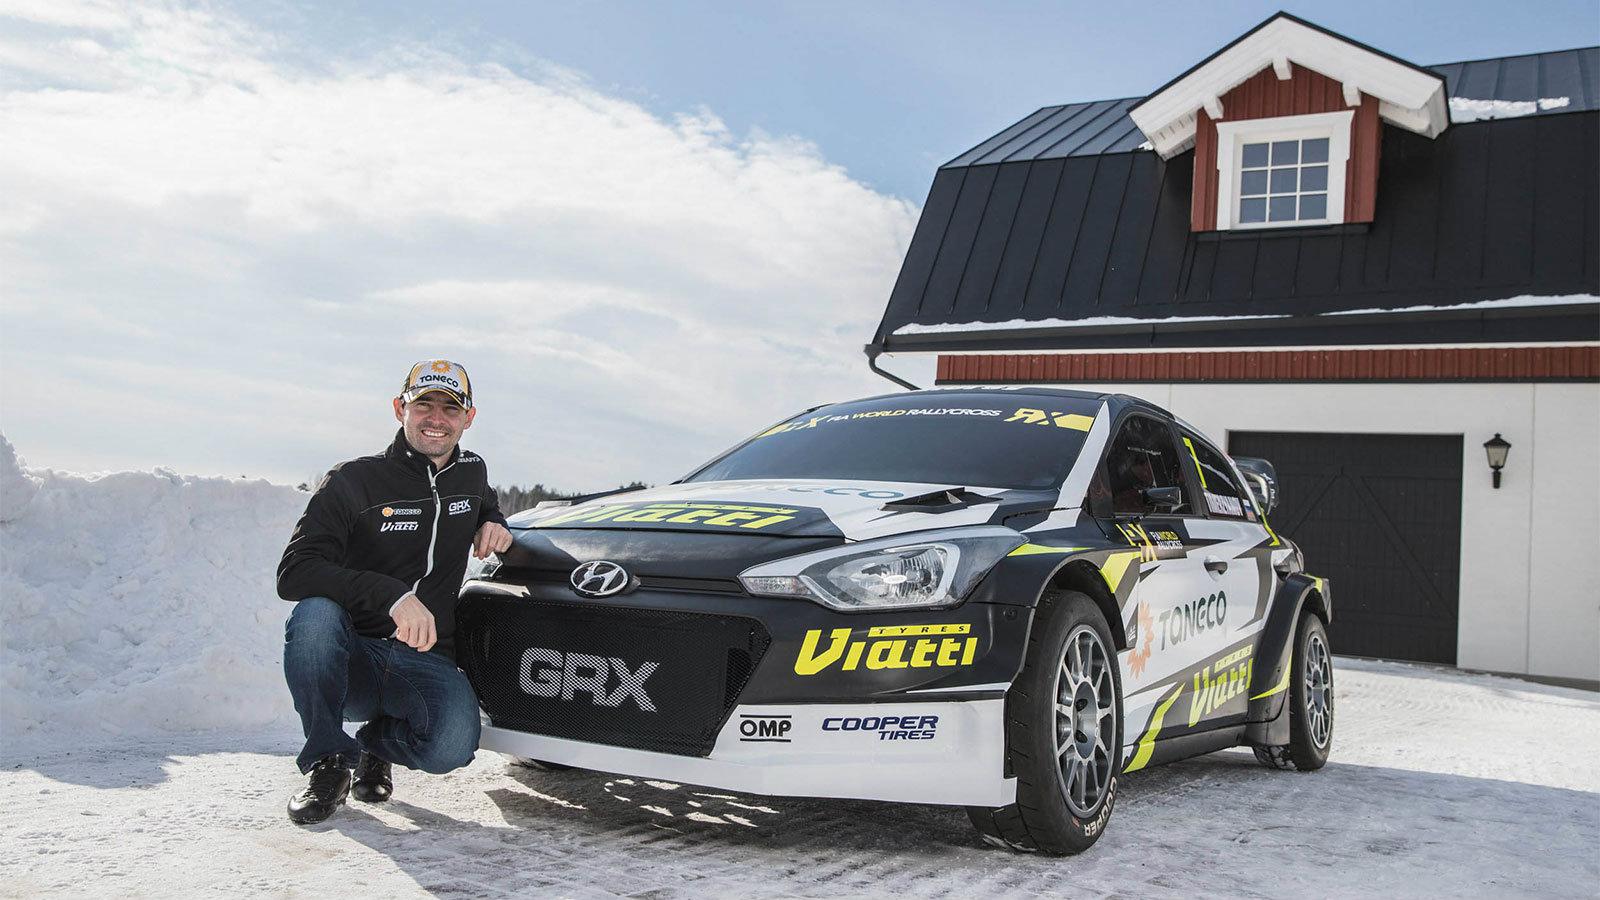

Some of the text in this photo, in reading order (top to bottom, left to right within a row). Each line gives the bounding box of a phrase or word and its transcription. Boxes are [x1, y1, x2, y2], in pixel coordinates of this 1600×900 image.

[420, 374, 459, 388] TANECO
[852, 408, 908, 419] WORLD
[906, 408, 1002, 416] RALLYCROSS
[448, 499, 471, 511] GRX
[1159, 590, 1227, 651] TANECO
[878, 626, 965, 634] TYRES
[794, 628, 978, 676] Viatti
[519, 647, 660, 713] GRX
[1188, 657, 1254, 728] Viatti
[740, 719, 792, 737] OMP
[822, 715, 939, 731] COOPER
[878, 730, 936, 740] TIRES
[1084, 776, 1117, 836] COOPER
